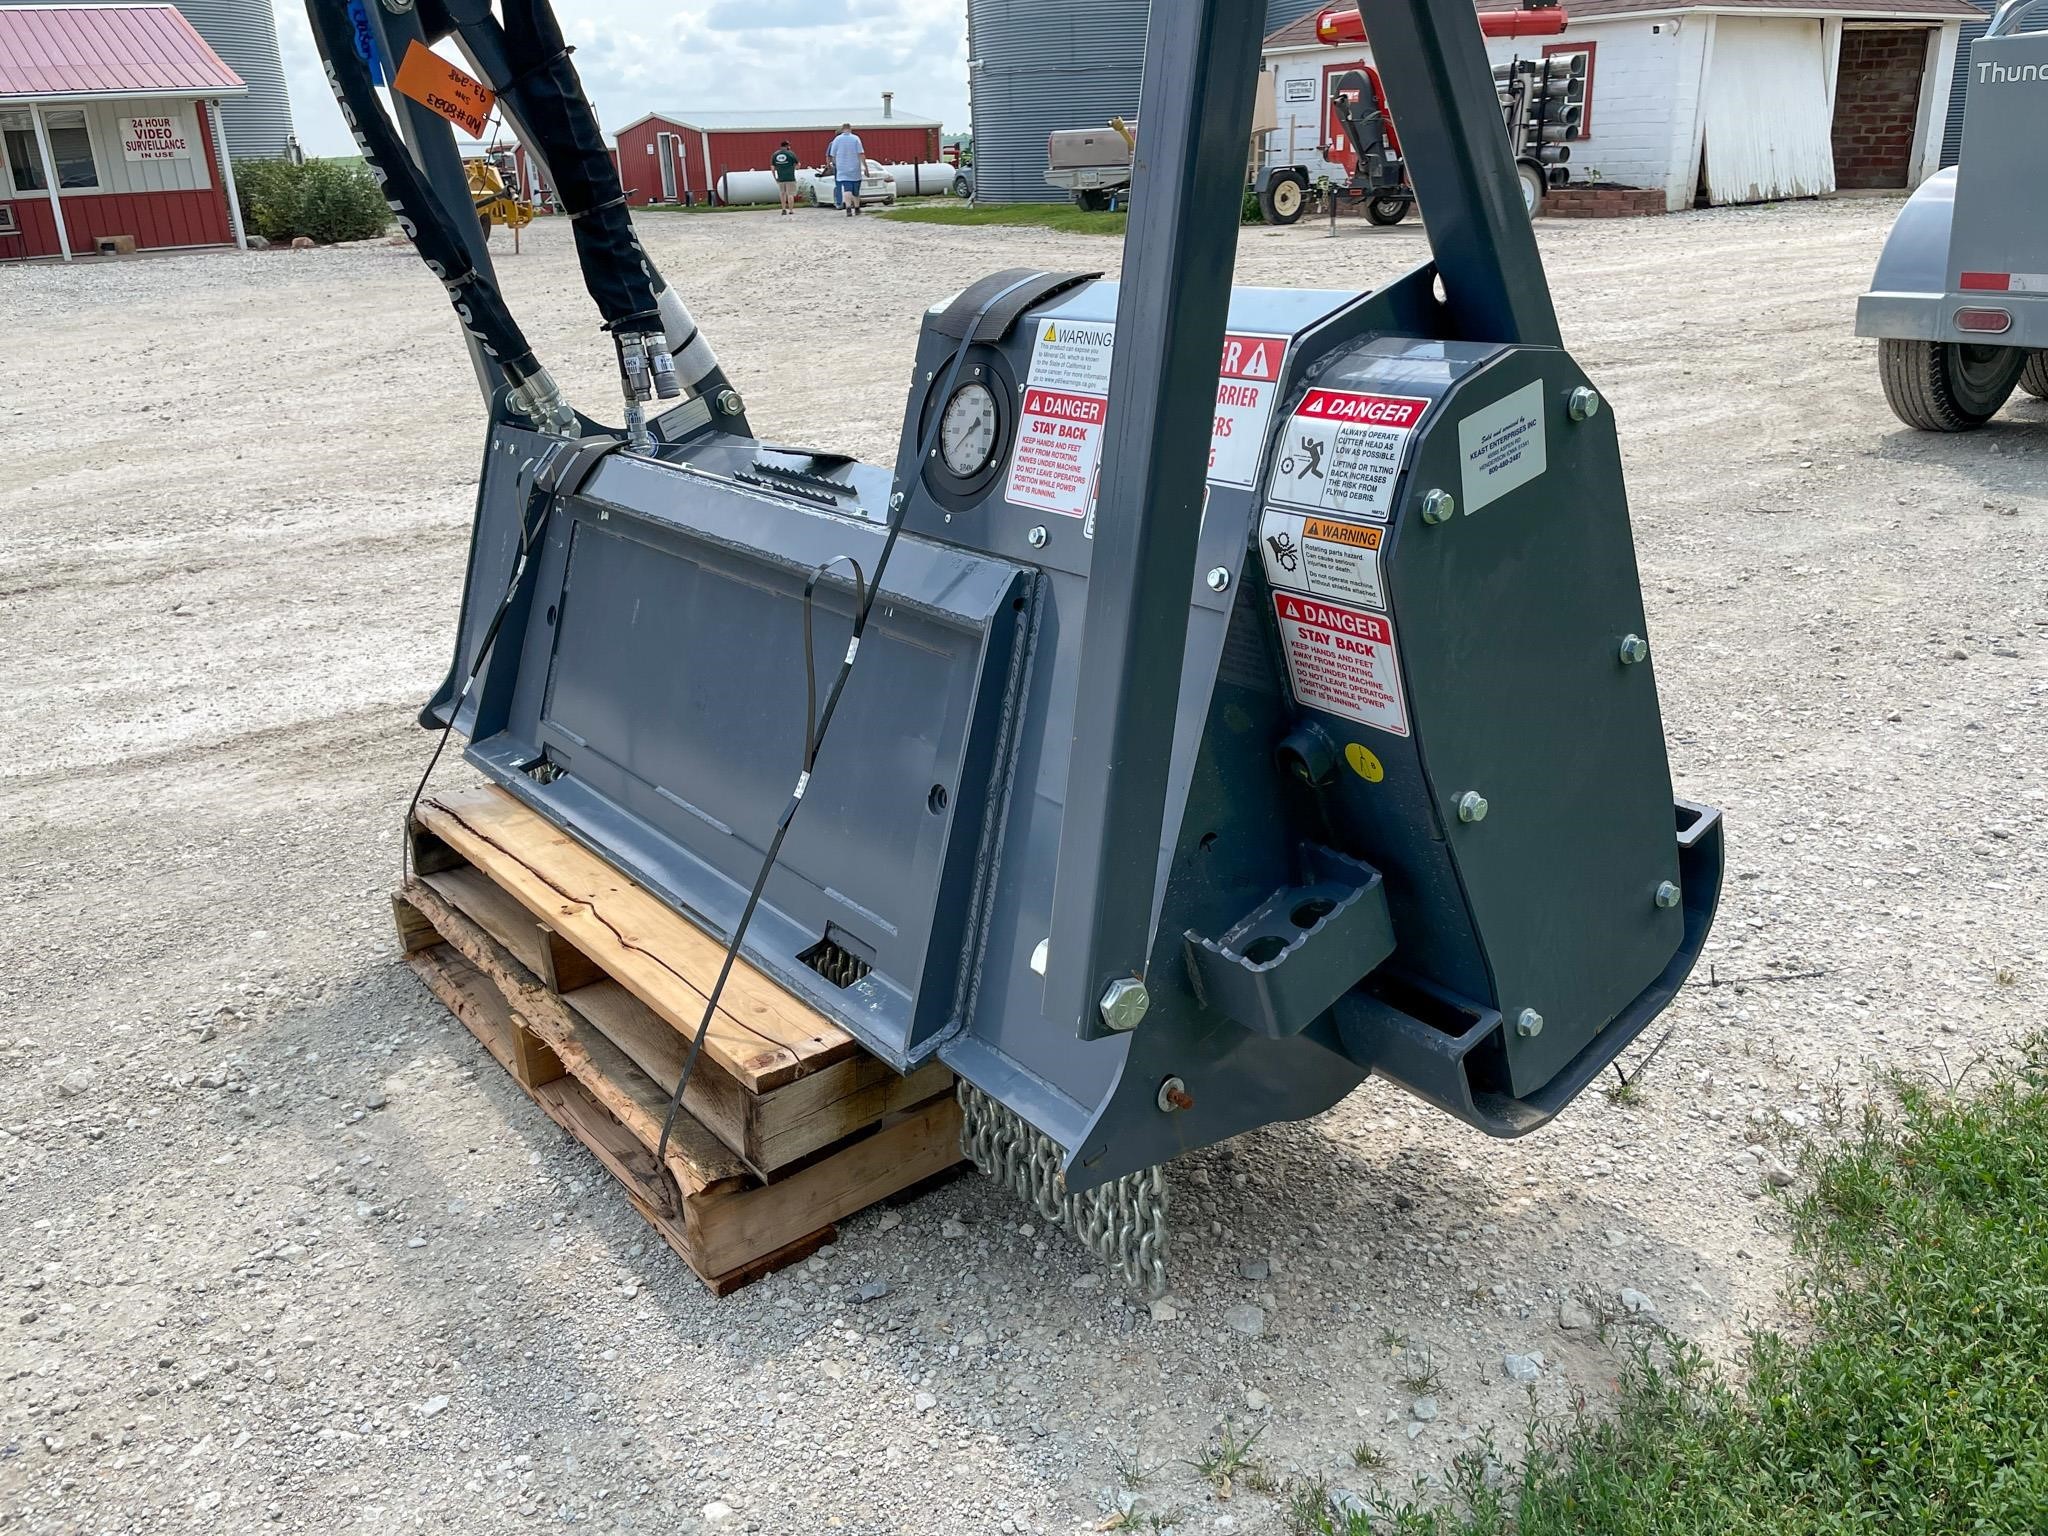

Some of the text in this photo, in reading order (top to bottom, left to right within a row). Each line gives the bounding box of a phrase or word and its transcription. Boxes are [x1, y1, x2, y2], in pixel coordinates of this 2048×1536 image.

[132, 119, 170, 128] 24 HOUR
[323, 59, 388, 187] MSHA
[135, 129, 172, 139] VIDEO
[126, 139, 186, 151] SURVEILLANCE
[1217, 384, 1259, 408] RRIER
[1044, 396, 1099, 420] DANGER
[1327, 399, 1413, 423] DANGER
[1032, 421, 1088, 440] STAY BACK
[1341, 428, 1399, 441] ALWAYS OPERATE
[1022, 436, 1081, 452] KEEP HANDS AND FEET
[1338, 437, 1364, 446] CUTTER
[1365, 440, 1384, 449] HEAD
[1470, 445, 1488, 460] KEAST
[1489, 425, 1526, 449] ENTERPRISES
[1528, 419, 1536, 429] INC
[1035, 448, 1050, 457] FROM
[1051, 451, 1077, 462] ROTATING
[1336, 447, 1351, 455] LOW
[1362, 450, 1395, 460] POSSIBLE.
[1019, 456, 1081, 473] KNIVES UNDER MACHINE
[1333, 460, 1357, 470] LIFTING
[1370, 465, 1393, 474] TILTING
[1015, 474, 1076, 492] POSITION WHILE POWER
[1025, 466, 1036, 474] NOT
[1037, 468, 1052, 478] LEAVE
[1053, 471, 1085, 484] OPERATORS
[1330, 469, 1386, 484] BACK INCREASES
[1031, 488, 1056, 499] RUNNING.
[1326, 488, 1374, 502] FLYING DEBRIS.
[1342, 481, 1357, 489] RISK
[1358, 483, 1377, 492] FROM
[1323, 525, 1376, 546] WARNING
[1305, 544, 1327, 554] Rotating
[1344, 551, 1364, 560] hazard.
[1307, 560, 1327, 569] injuries
[1336, 565, 1352, 573] death.
[1335, 558, 1355, 567] serious
[1311, 579, 1330, 587] without
[1352, 587, 1377, 597] attached.
[1328, 575, 1348, 584] operate
[1350, 580, 1373, 589] machine
[1304, 604, 1381, 639] DANGER
[1298, 627, 1376, 658] STAY BACK
[1291, 641, 1373, 669] KEEP HANDS AND FEET
[1294, 650, 1373, 678] AWAY FROM ROTATING
[1295, 660, 1383, 691] KNIVES UNDER MACHINE
[1299, 678, 1385, 709] POSITION WHILE POWER
[1309, 672, 1322, 680] NOT
[1325, 677, 1348, 689] LEAVE
[1349, 683, 1394, 702] OPERATORS
[1300, 687, 1316, 697] UNIT
[1327, 695, 1362, 711] RUNNING.
